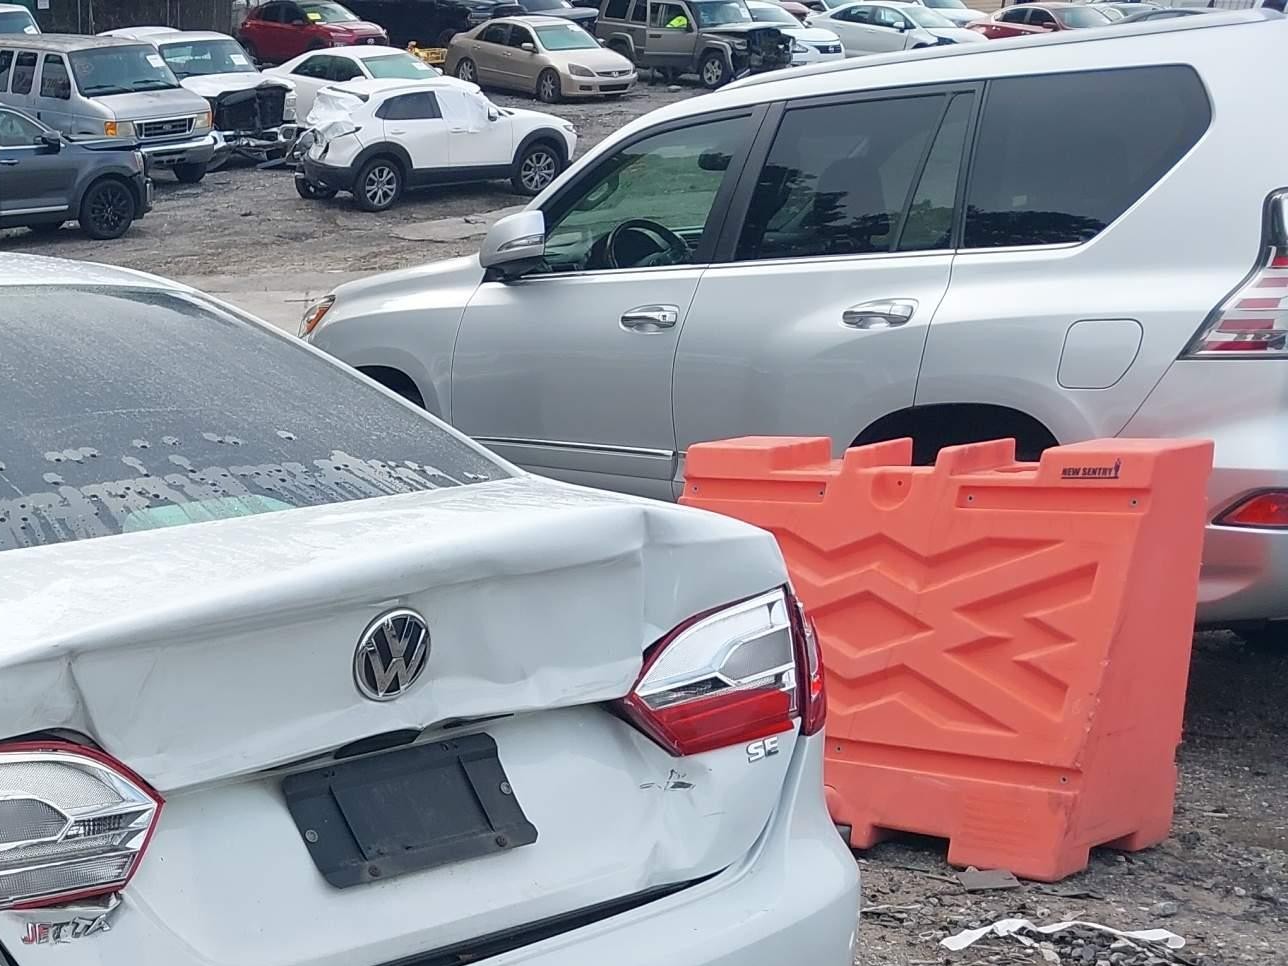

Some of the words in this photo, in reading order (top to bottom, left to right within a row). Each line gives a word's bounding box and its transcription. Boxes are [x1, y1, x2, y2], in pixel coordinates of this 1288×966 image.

[1062, 467, 1081, 476] NEW
[1081, 467, 1113, 476] SENTRY
[746, 736, 779, 763] SE
[21, 914, 111, 945] JETTA
